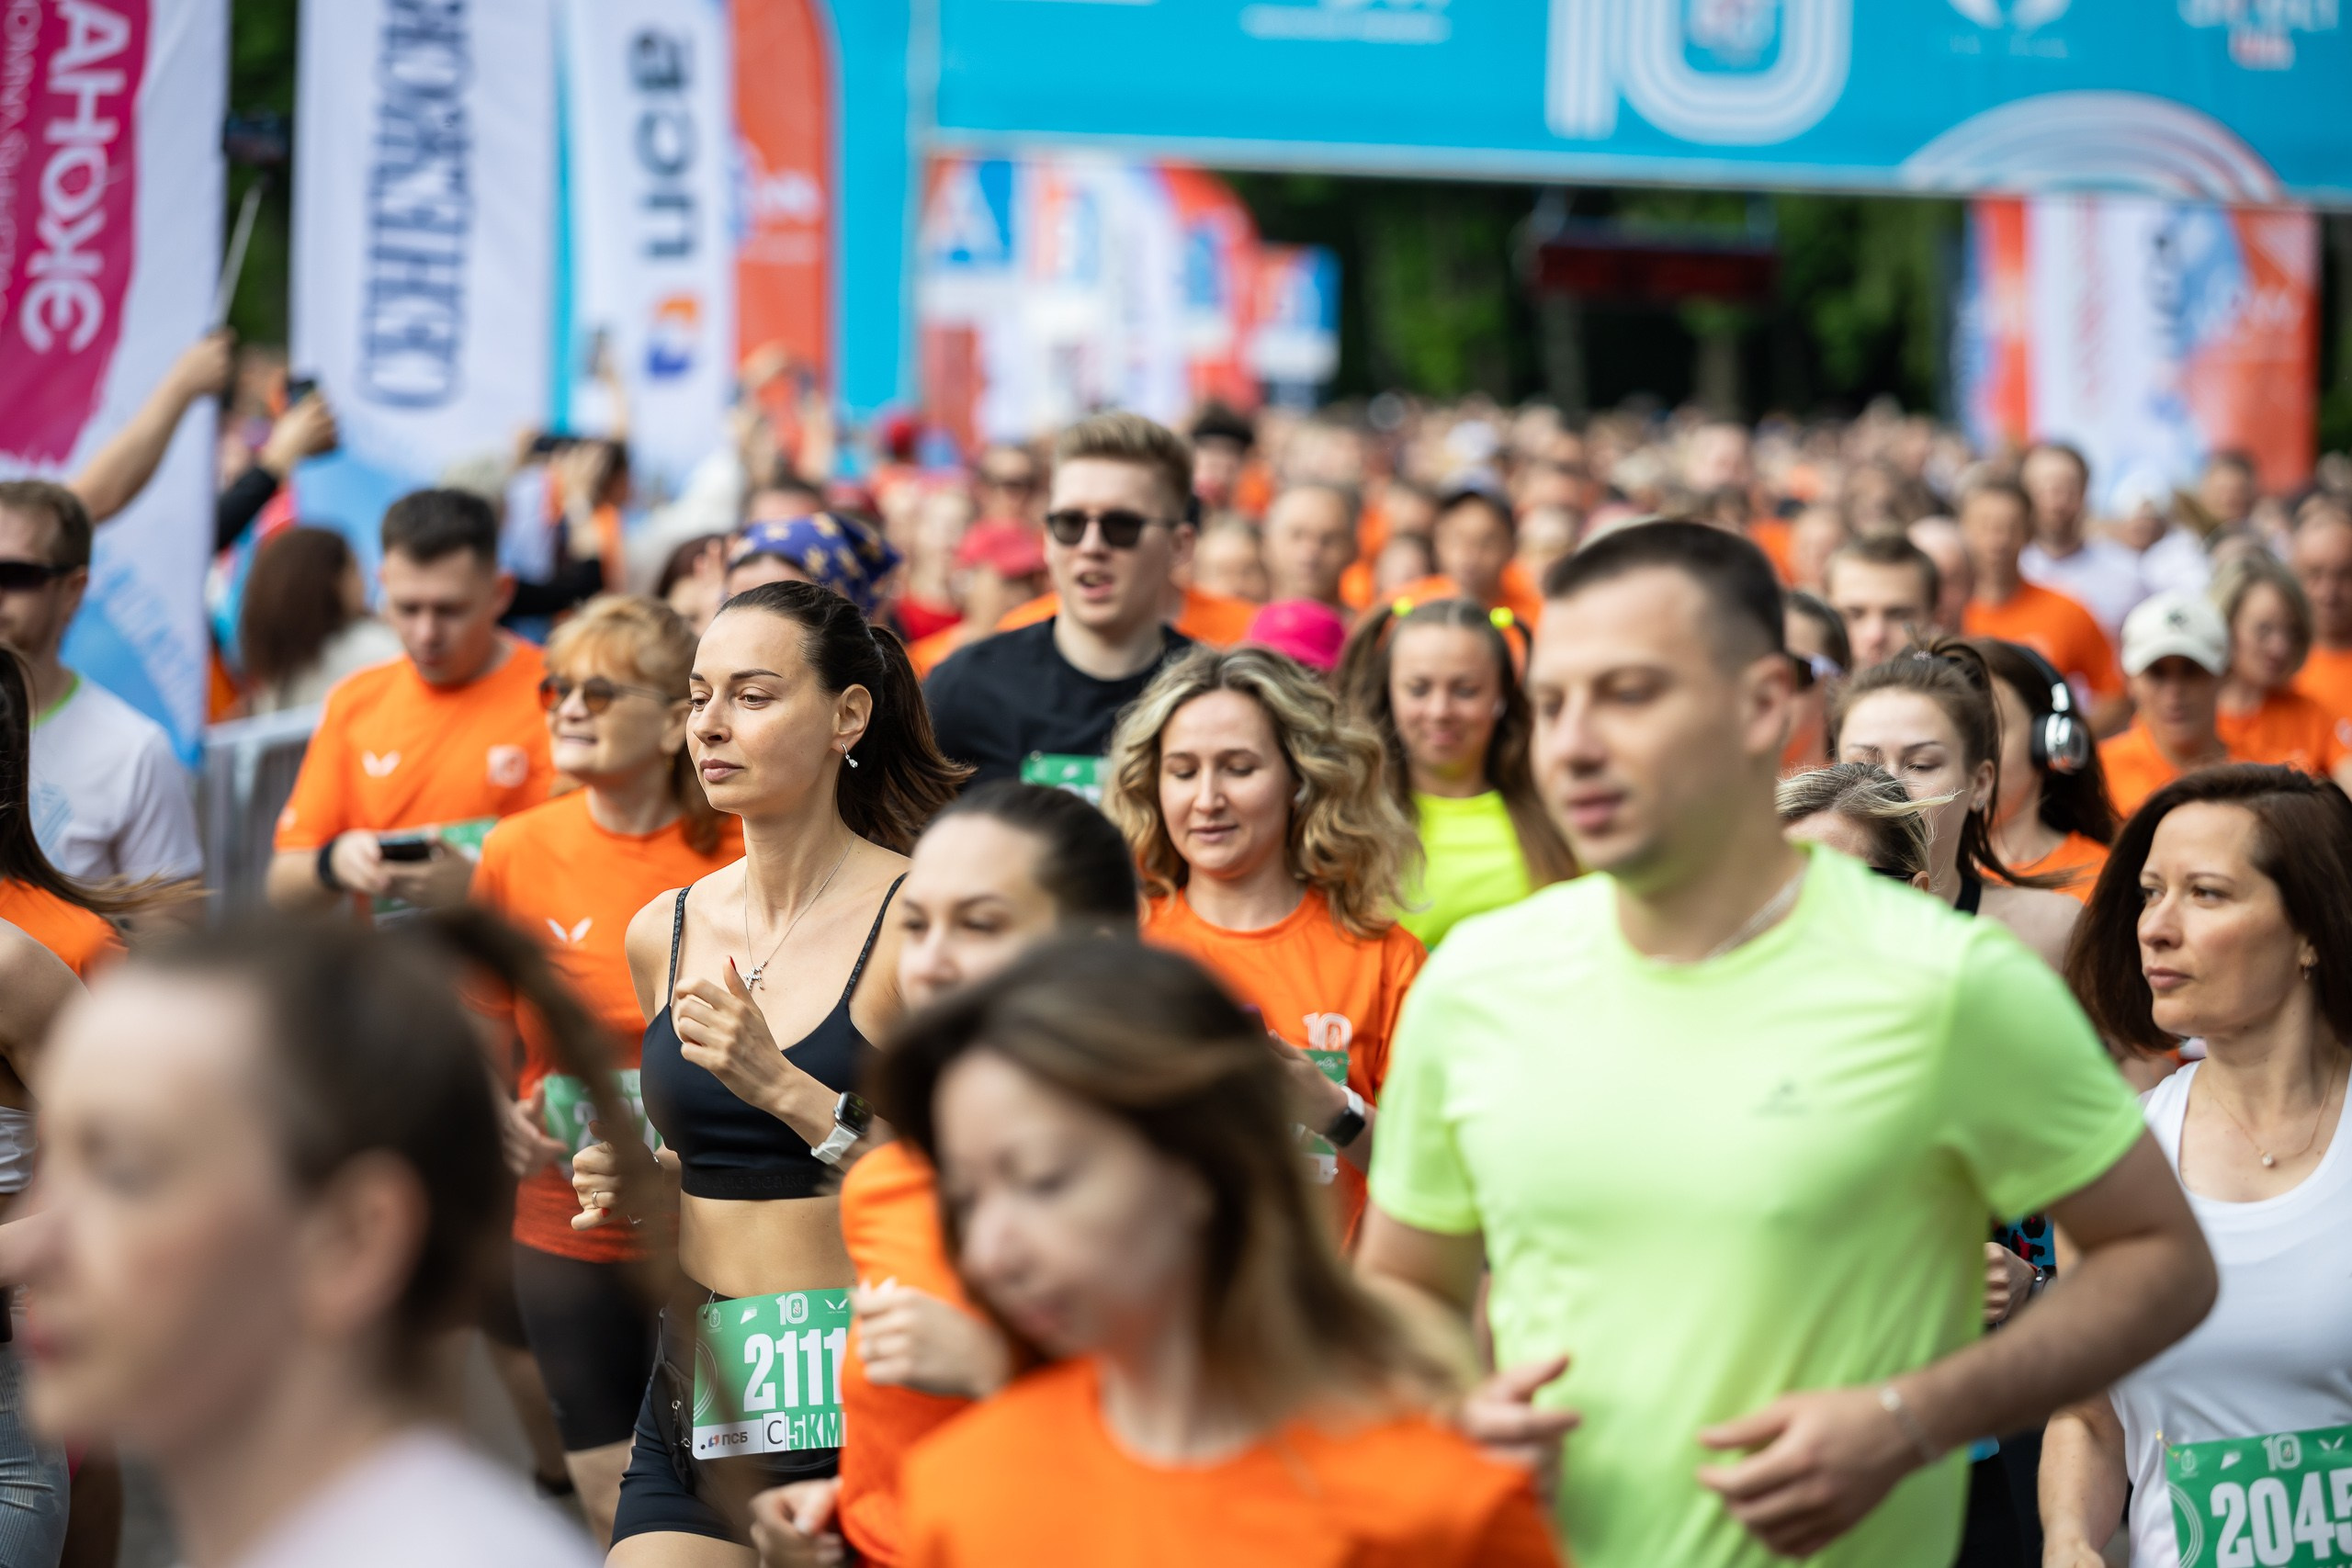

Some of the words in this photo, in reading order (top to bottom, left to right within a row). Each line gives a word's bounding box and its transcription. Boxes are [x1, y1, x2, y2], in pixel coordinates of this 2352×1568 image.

[1302, 1012, 1353, 1051] 10
[775, 1292, 808, 1325] 10
[743, 1327, 846, 1412] 2111
[722, 1432, 748, 1446] ПСБ
[2261, 1433, 2302, 1471] 10
[2210, 1467, 2352, 1568] 2045
